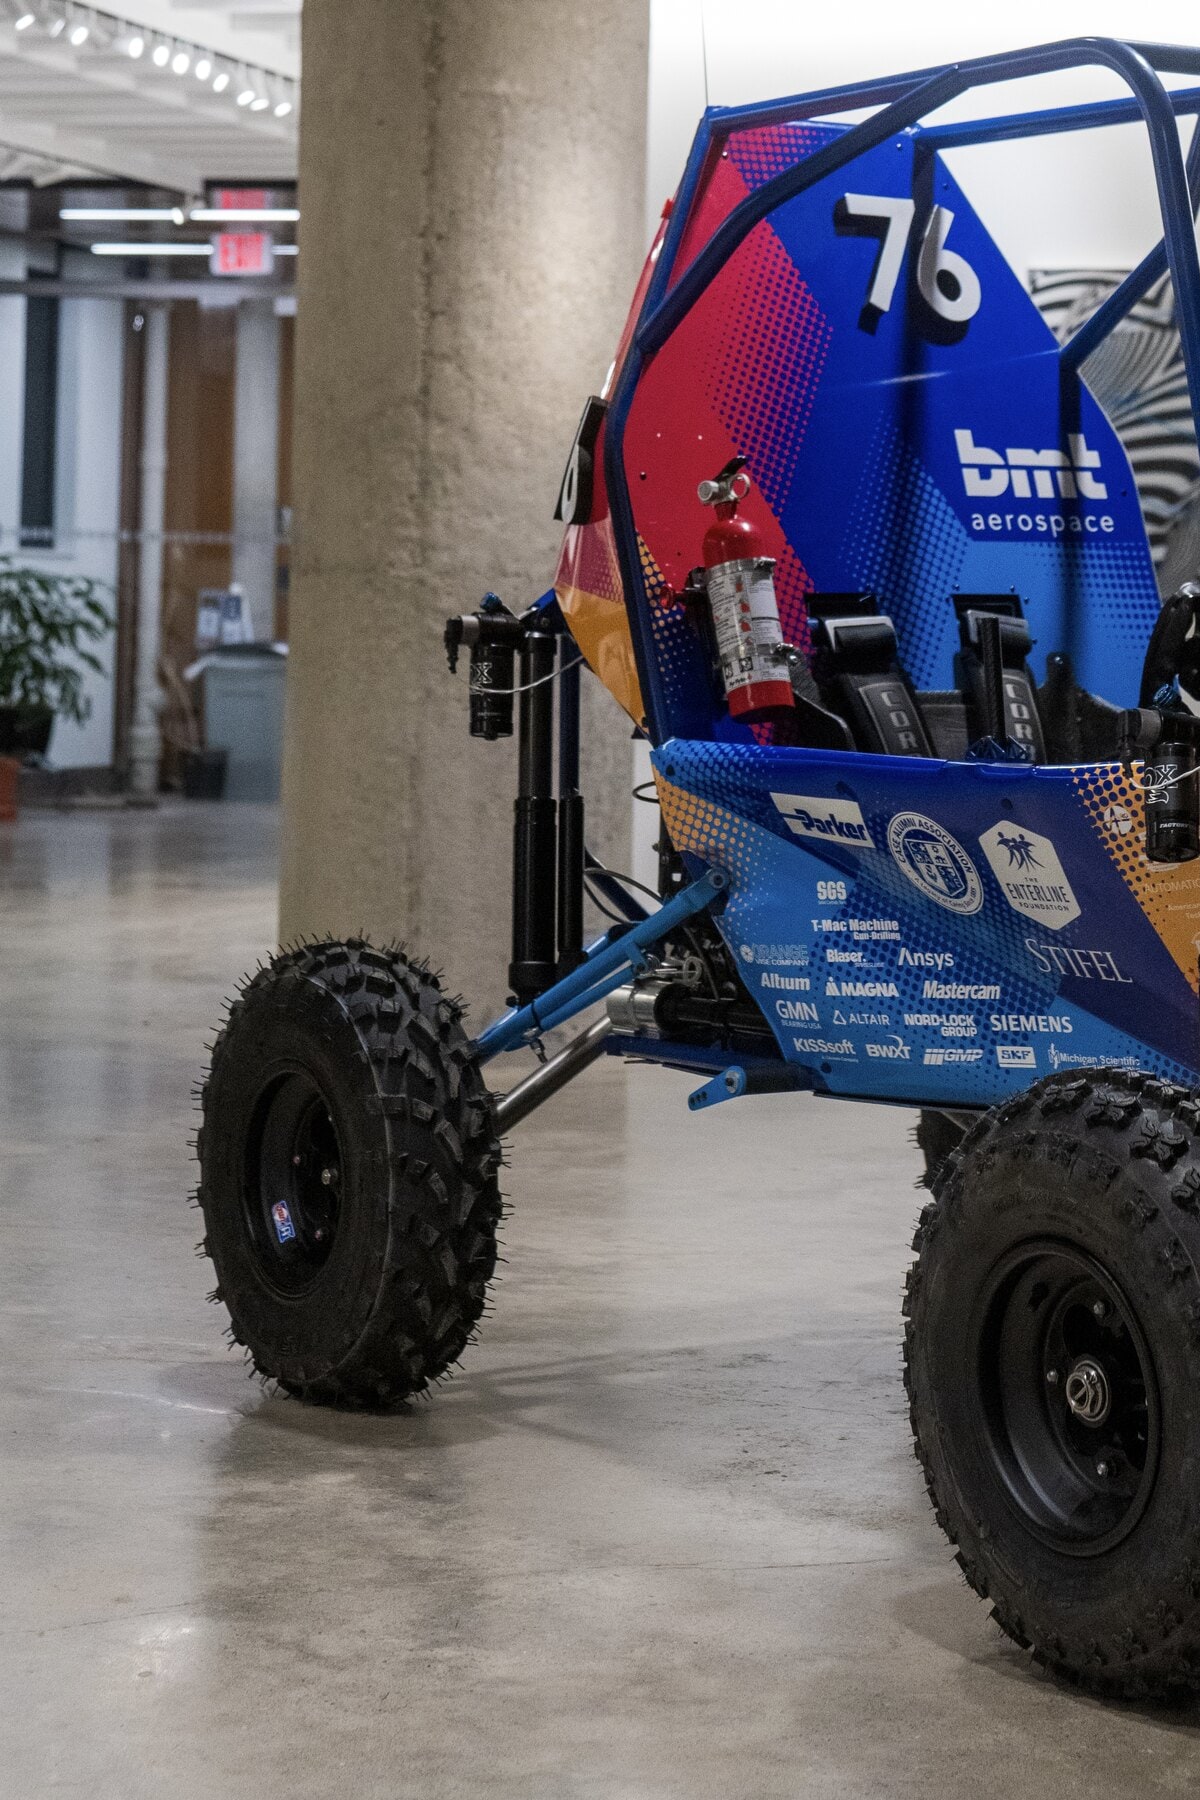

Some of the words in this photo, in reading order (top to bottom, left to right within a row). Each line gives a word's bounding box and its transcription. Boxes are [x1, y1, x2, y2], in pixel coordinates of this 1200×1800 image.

[843, 191, 982, 324] 76
[953, 428, 1108, 500] bmt
[971, 512, 1115, 538] aerospace
[793, 808, 869, 842] Parker
[892, 817, 917, 838] ALUMNI
[891, 838, 907, 864] CASE
[918, 819, 975, 875] ASSOCIATION
[815, 880, 848, 901] SGS
[1005, 882, 1071, 904] ENTERLINE
[1019, 901, 1070, 912] FOUNDATION
[811, 919, 847, 932] T-Mac
[849, 918, 900, 932] Machine
[853, 931, 901, 941] Gun-Drilling
[771, 959, 810, 967] COMPANY
[898, 947, 955, 971] Ansys
[1024, 938, 1133, 983] STIFEL
[841, 982, 900, 998] MAGNA
[922, 980, 1001, 1000] Mastercam
[775, 1000, 819, 1022] GMN
[849, 1013, 891, 1026] ALTAIR
[903, 1013, 976, 1027] NORD-LOCK
[940, 1026, 978, 1037] GROUP
[989, 1014, 1074, 1034] SIEMENS
[793, 1037, 857, 1055] KISSsoft
[865, 1038, 912, 1060] BWXT
[1001, 1049, 1032, 1060] SKF
[1059, 1052, 1098, 1066] Michigan
[1100, 1054, 1142, 1067] Scientific
